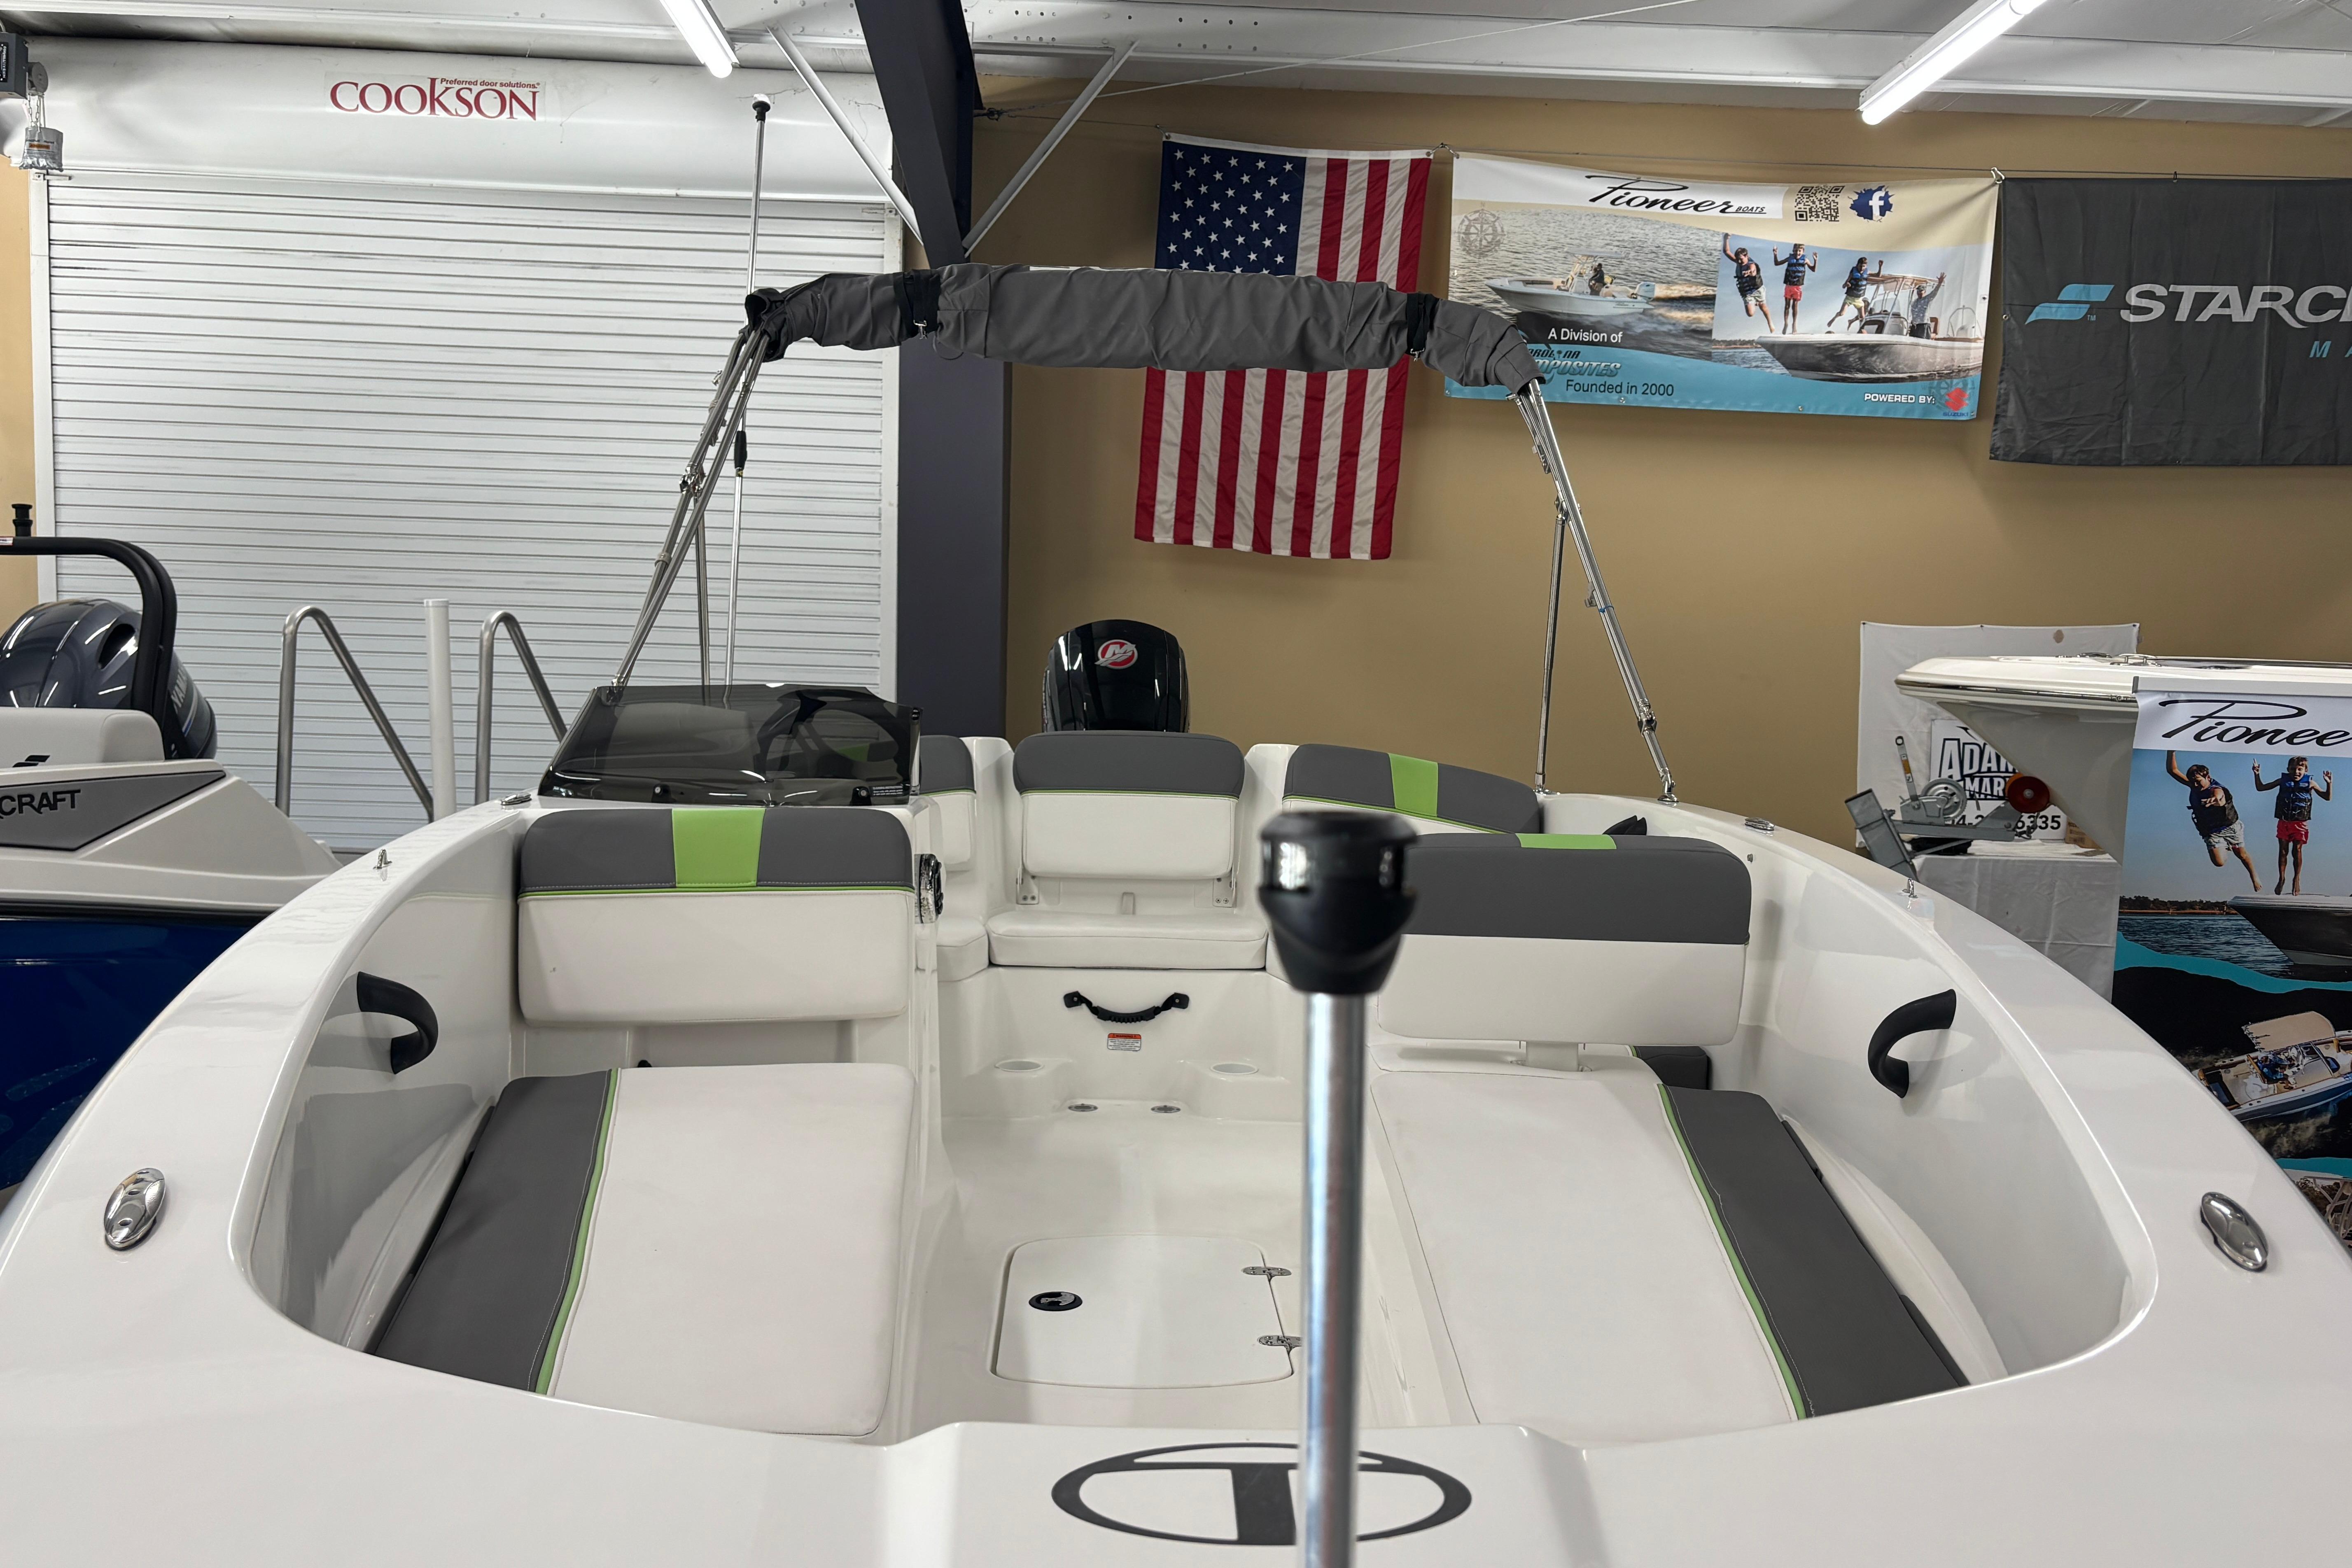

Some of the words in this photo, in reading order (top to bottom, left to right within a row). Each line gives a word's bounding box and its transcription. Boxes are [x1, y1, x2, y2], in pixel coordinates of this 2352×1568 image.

[441, 78, 478, 86] Preferred
[330, 77, 539, 121] COOKSON
[1585, 175, 1734, 213] Pioneer
[2120, 284, 2352, 329] STARC
[1548, 328, 1557, 340] A
[1561, 329, 1607, 343] Division
[1610, 331, 1623, 343] of
[1566, 380, 1623, 394] Founded
[1626, 382, 1637, 394] in
[1642, 383, 1674, 396] 2000
[1864, 393, 1915, 403] POWERED
[1918, 395, 1935, 404] BY:
[2159, 699, 2352, 747] Pionee
